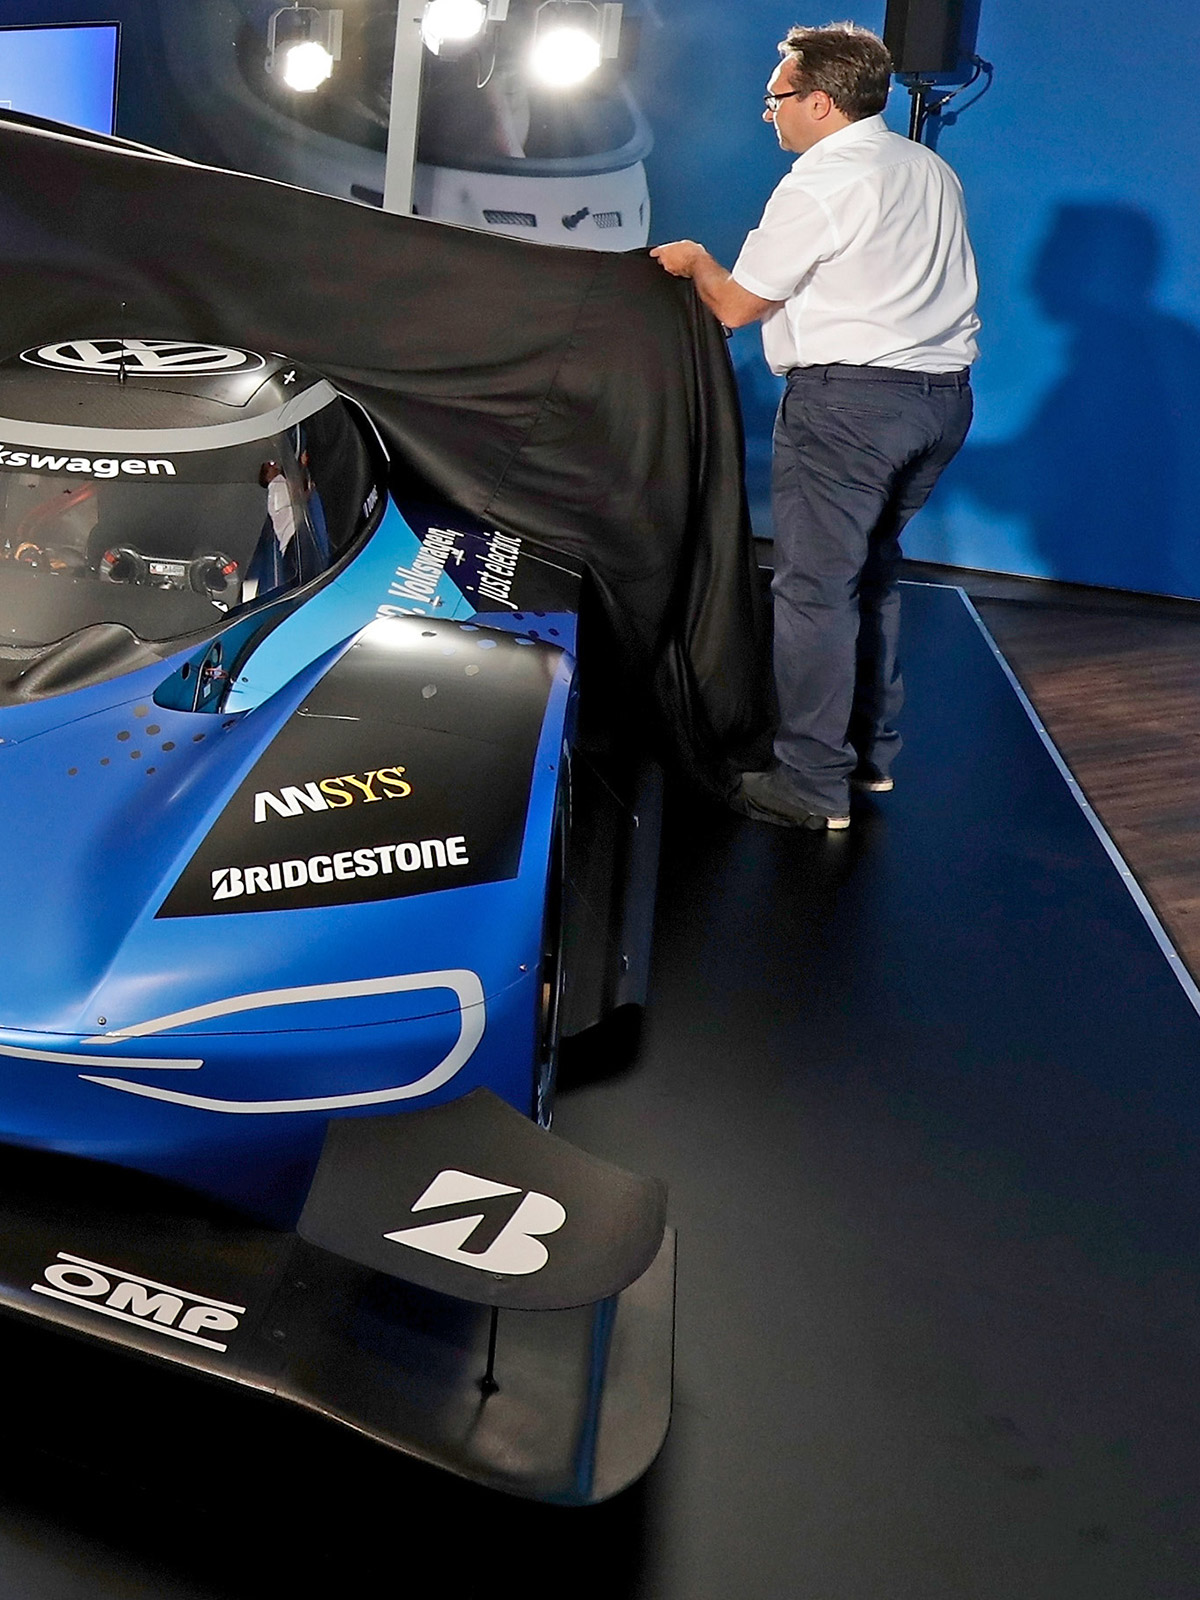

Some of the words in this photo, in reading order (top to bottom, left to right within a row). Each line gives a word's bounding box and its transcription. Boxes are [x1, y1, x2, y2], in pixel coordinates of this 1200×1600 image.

[475, 530, 522, 577] electric
[466, 570, 519, 610] just
[254, 765, 412, 823] ANSYS
[211, 836, 469, 900] BRIDGESTONE
[43, 1262, 240, 1335] OMP
